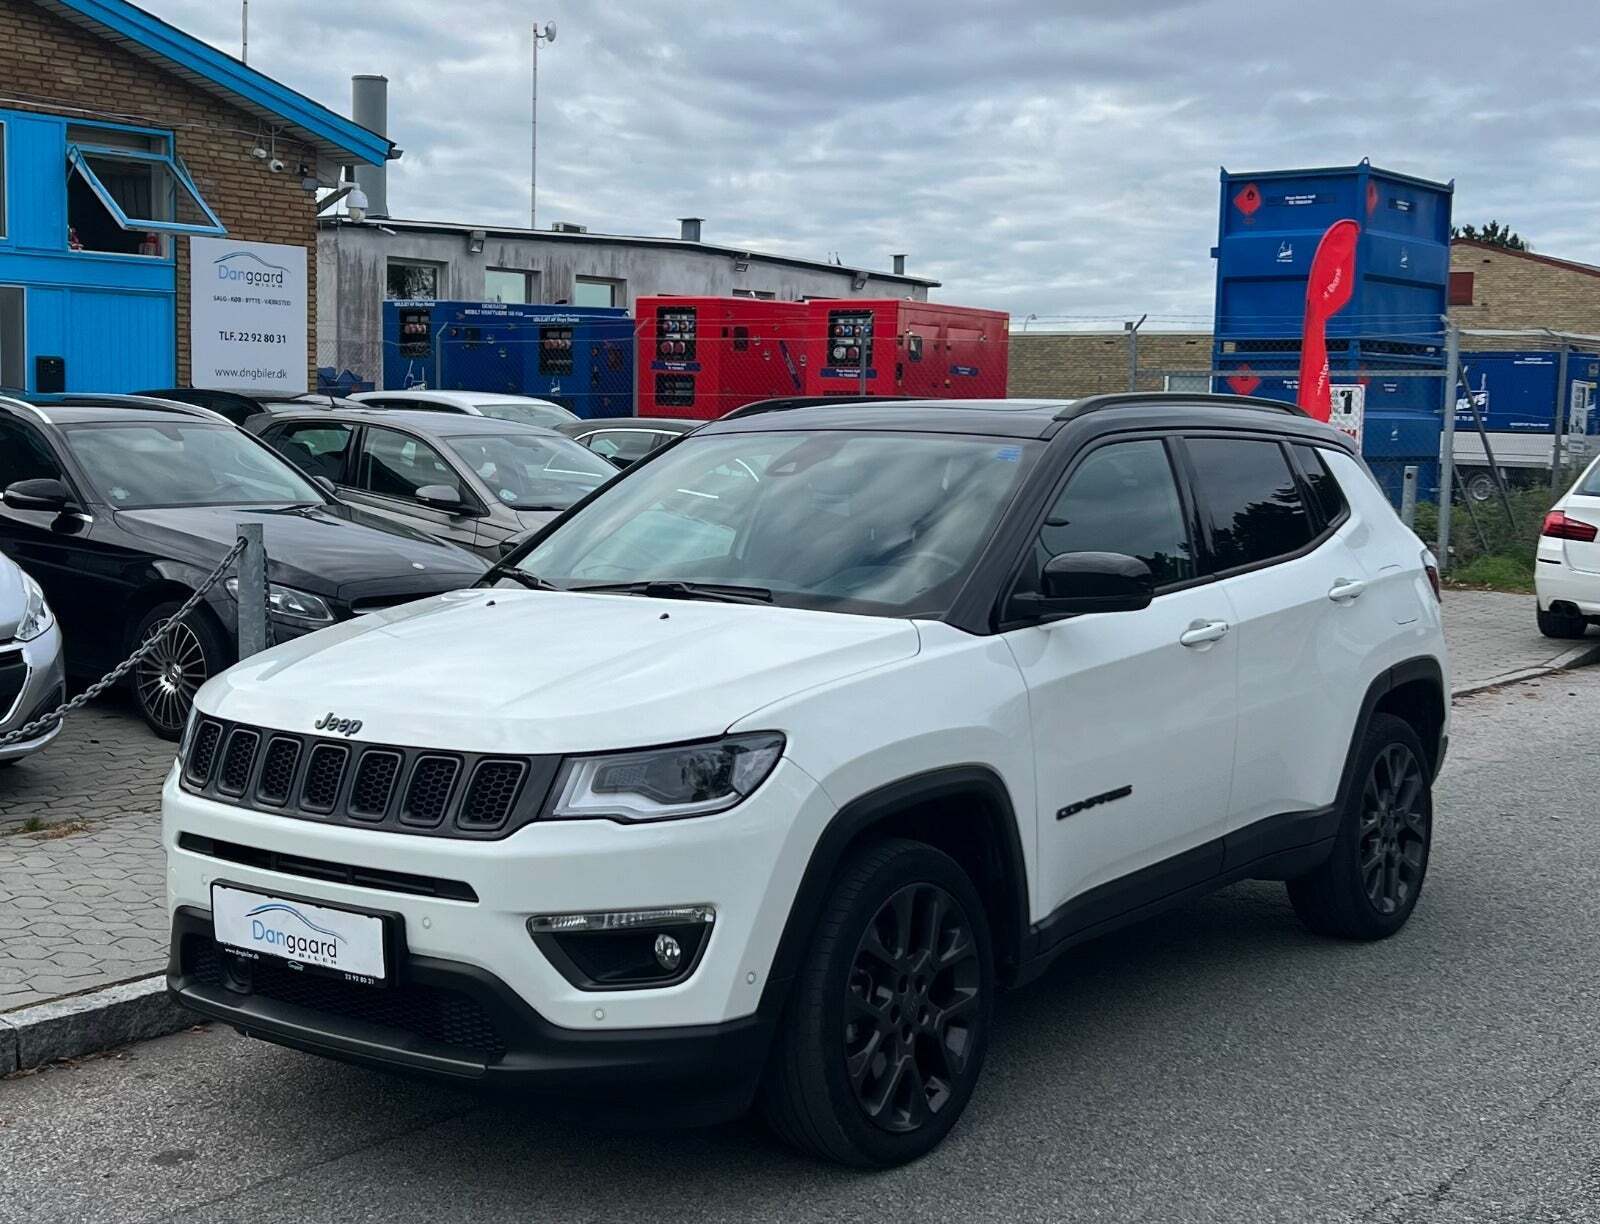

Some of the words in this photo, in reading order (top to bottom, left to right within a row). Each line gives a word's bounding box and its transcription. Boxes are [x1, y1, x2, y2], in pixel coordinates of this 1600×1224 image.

[218, 264, 283, 285] Dangaard
[219, 331, 237, 341] TLF.
[238, 332, 249, 342] 22
[251, 333, 262, 343] 92
[263, 334, 274, 343] 80
[276, 334, 286, 343] 31
[215, 368, 287, 380] www.dngbiler.dk
[314, 712, 363, 737] Jeep
[252, 919, 337, 958] Dangaard
[298, 952, 337, 965] BILER
